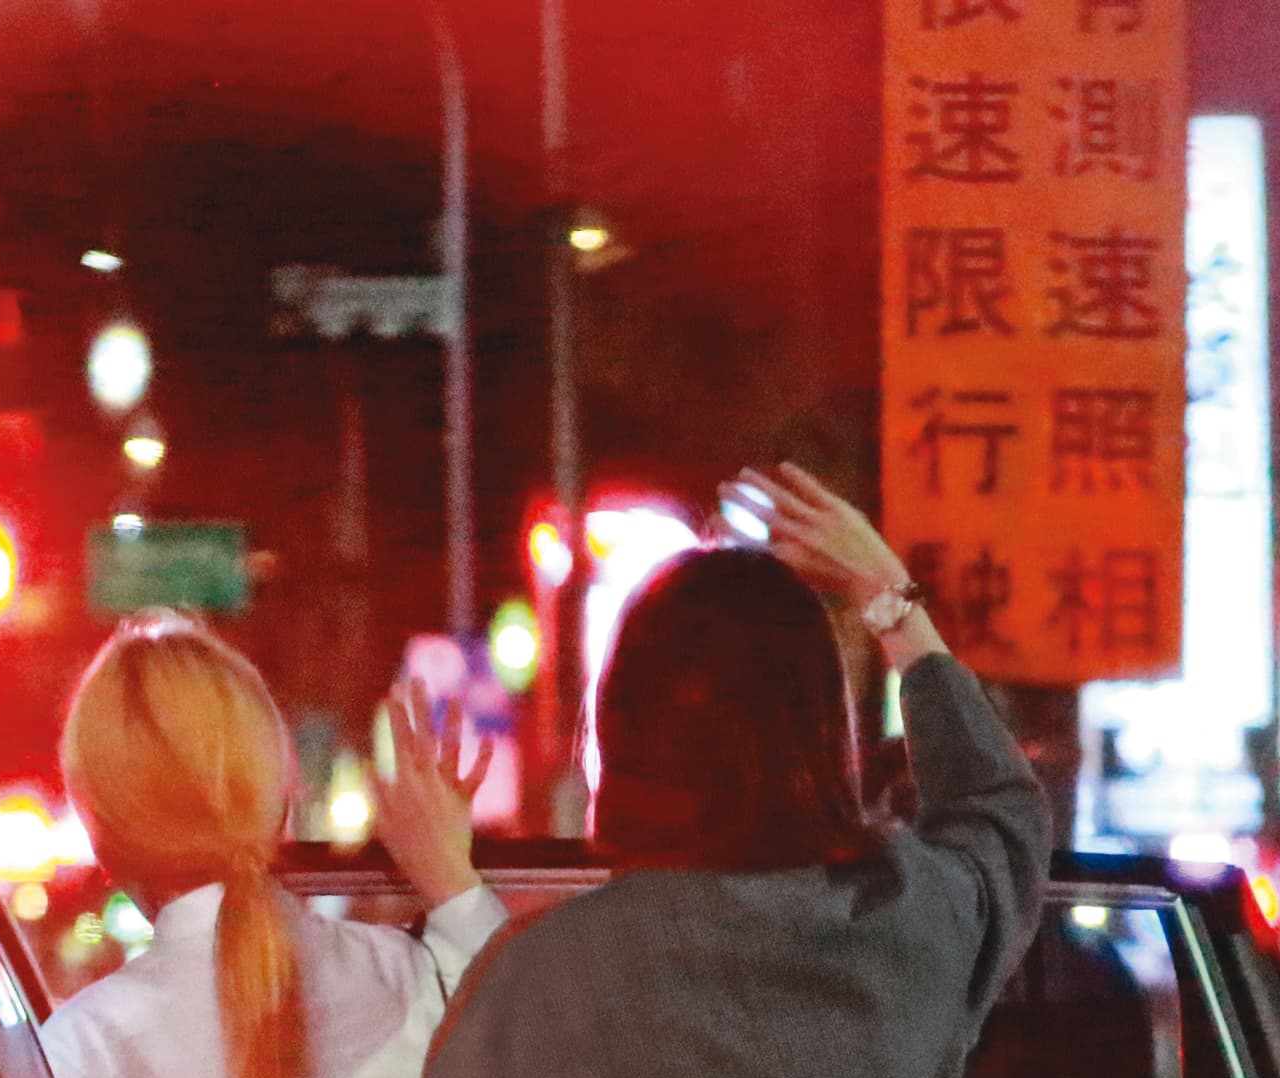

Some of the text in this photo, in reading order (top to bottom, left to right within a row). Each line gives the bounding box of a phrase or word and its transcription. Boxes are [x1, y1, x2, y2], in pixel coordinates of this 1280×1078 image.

[904, 0, 1021, 652] 速限行駛
[1042, 0, 1162, 652] 測速照相
